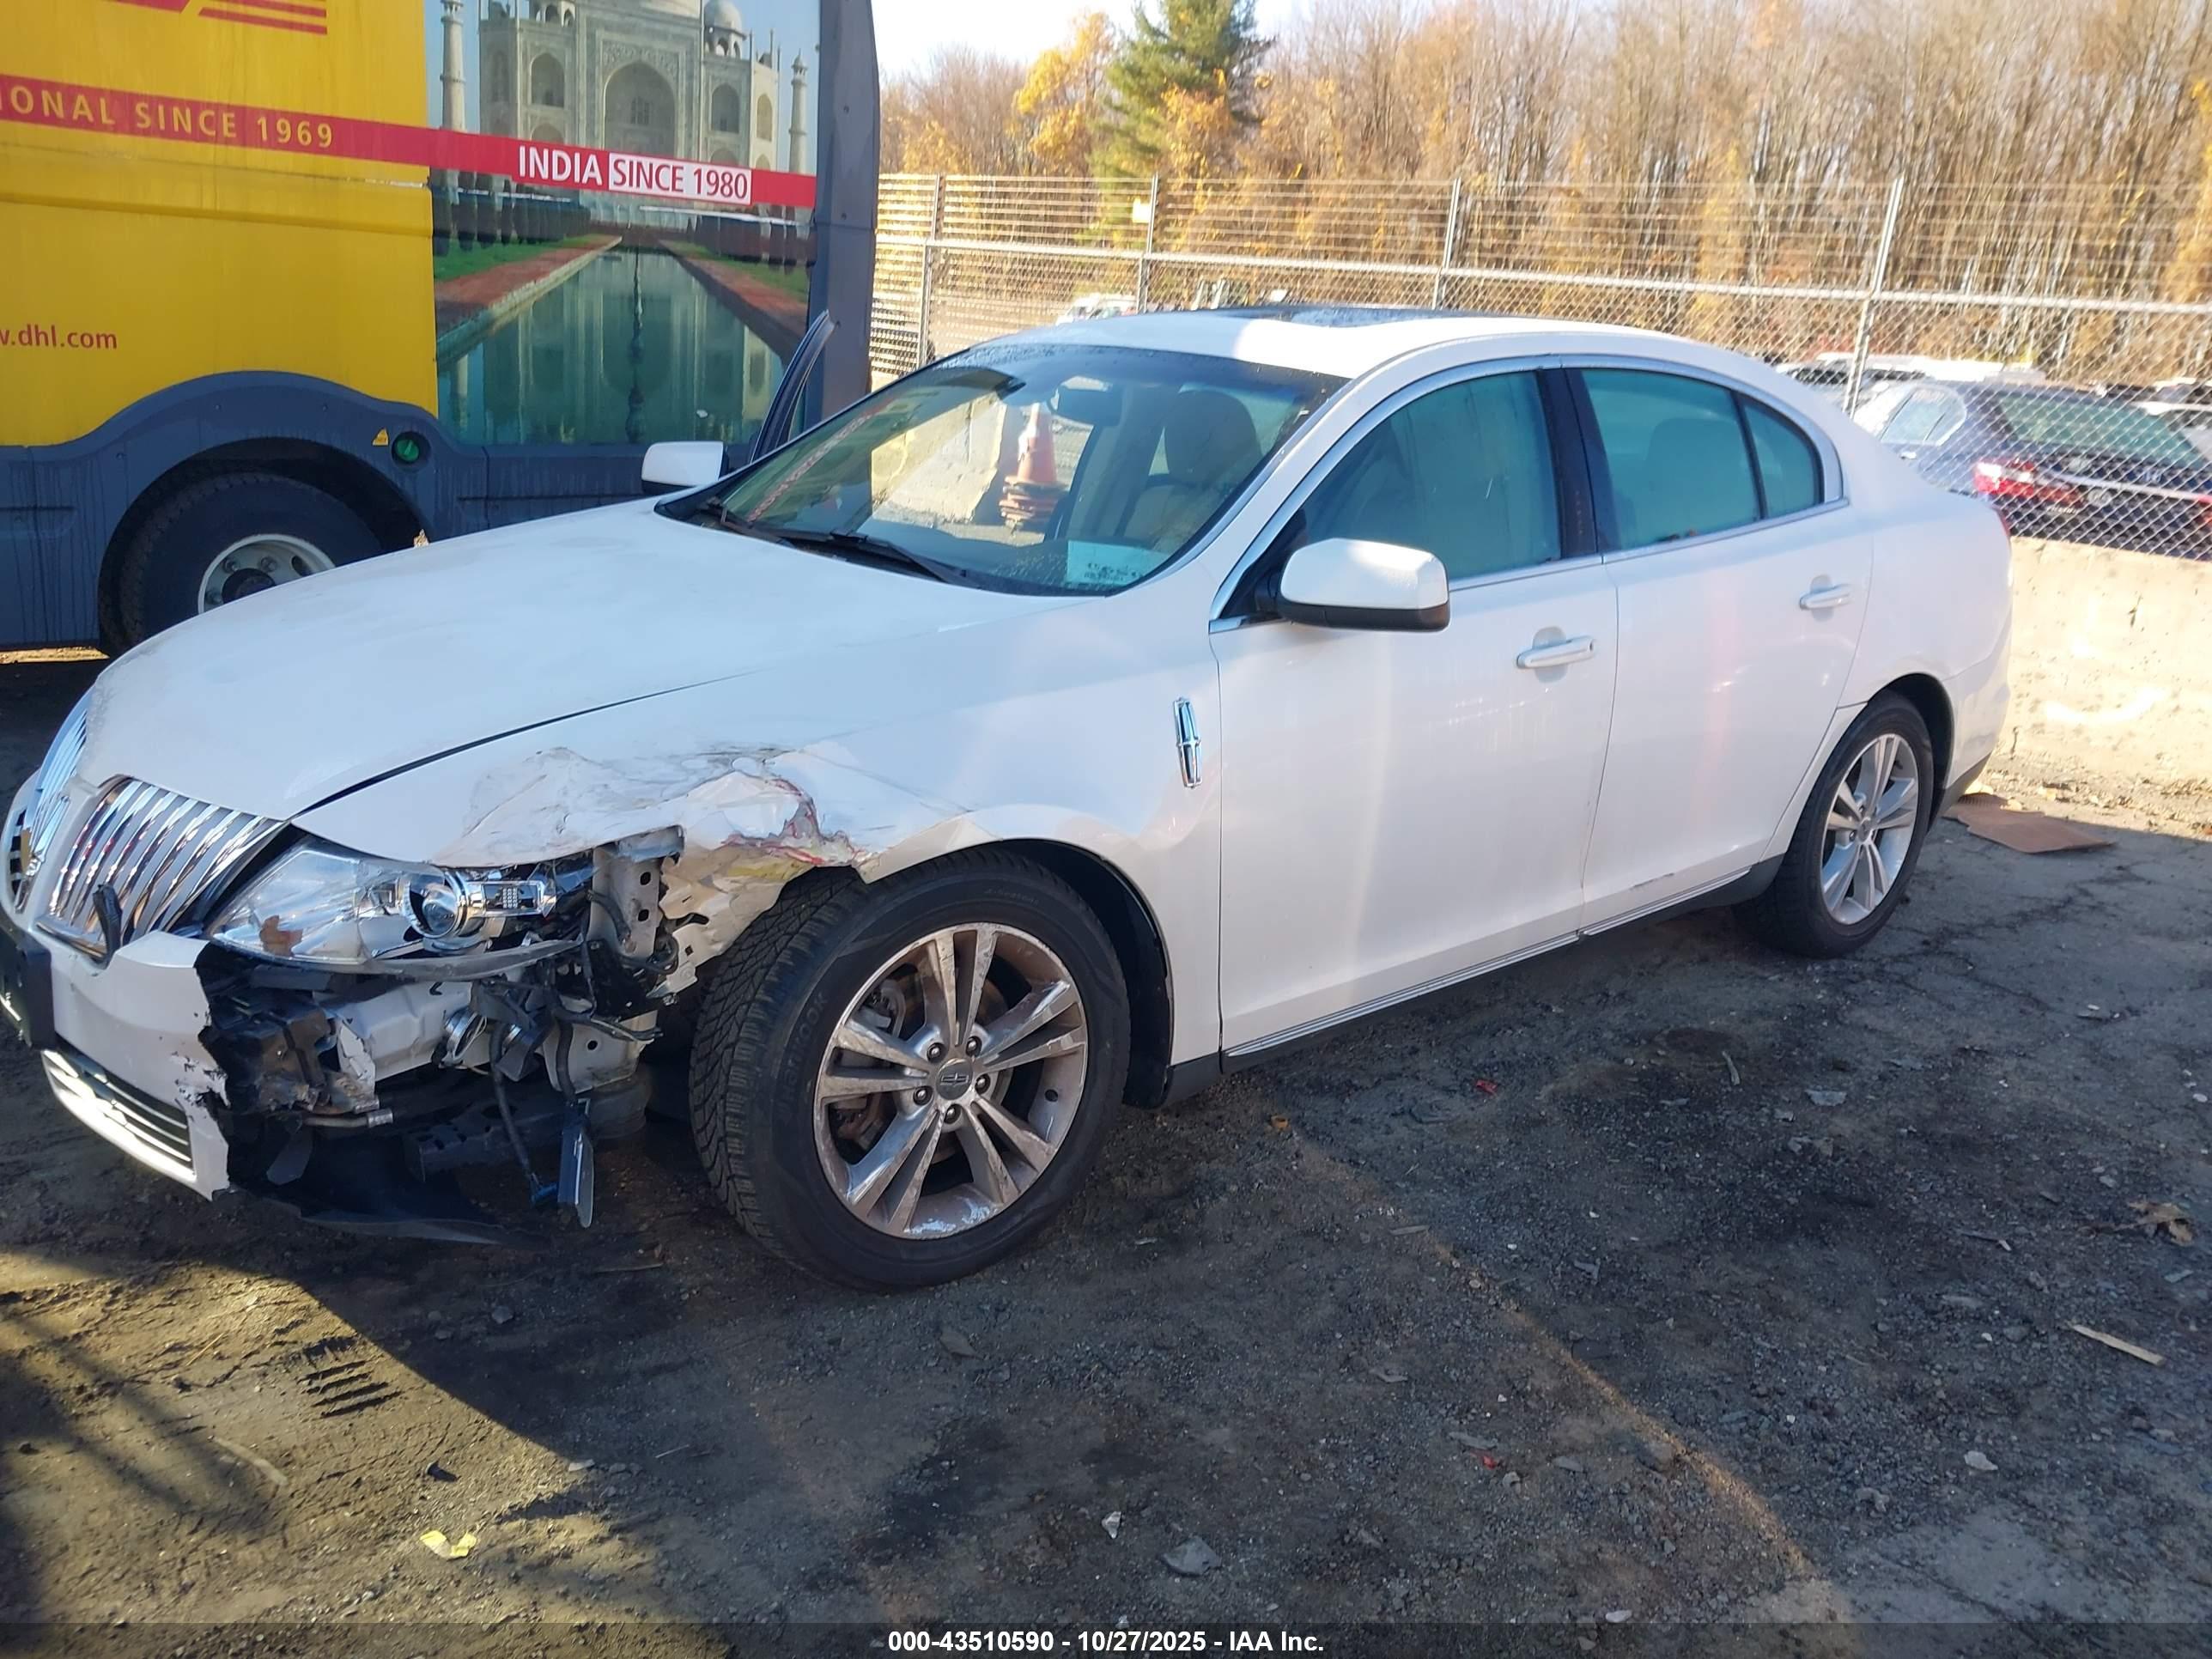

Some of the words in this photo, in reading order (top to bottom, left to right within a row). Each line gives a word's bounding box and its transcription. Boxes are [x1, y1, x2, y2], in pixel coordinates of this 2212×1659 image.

[135, 101, 238, 139] SINCE
[257, 116, 335, 149] 1969
[519, 144, 603, 186] INDIA
[612, 158, 684, 193] SINCE
[693, 168, 749, 199] 1980
